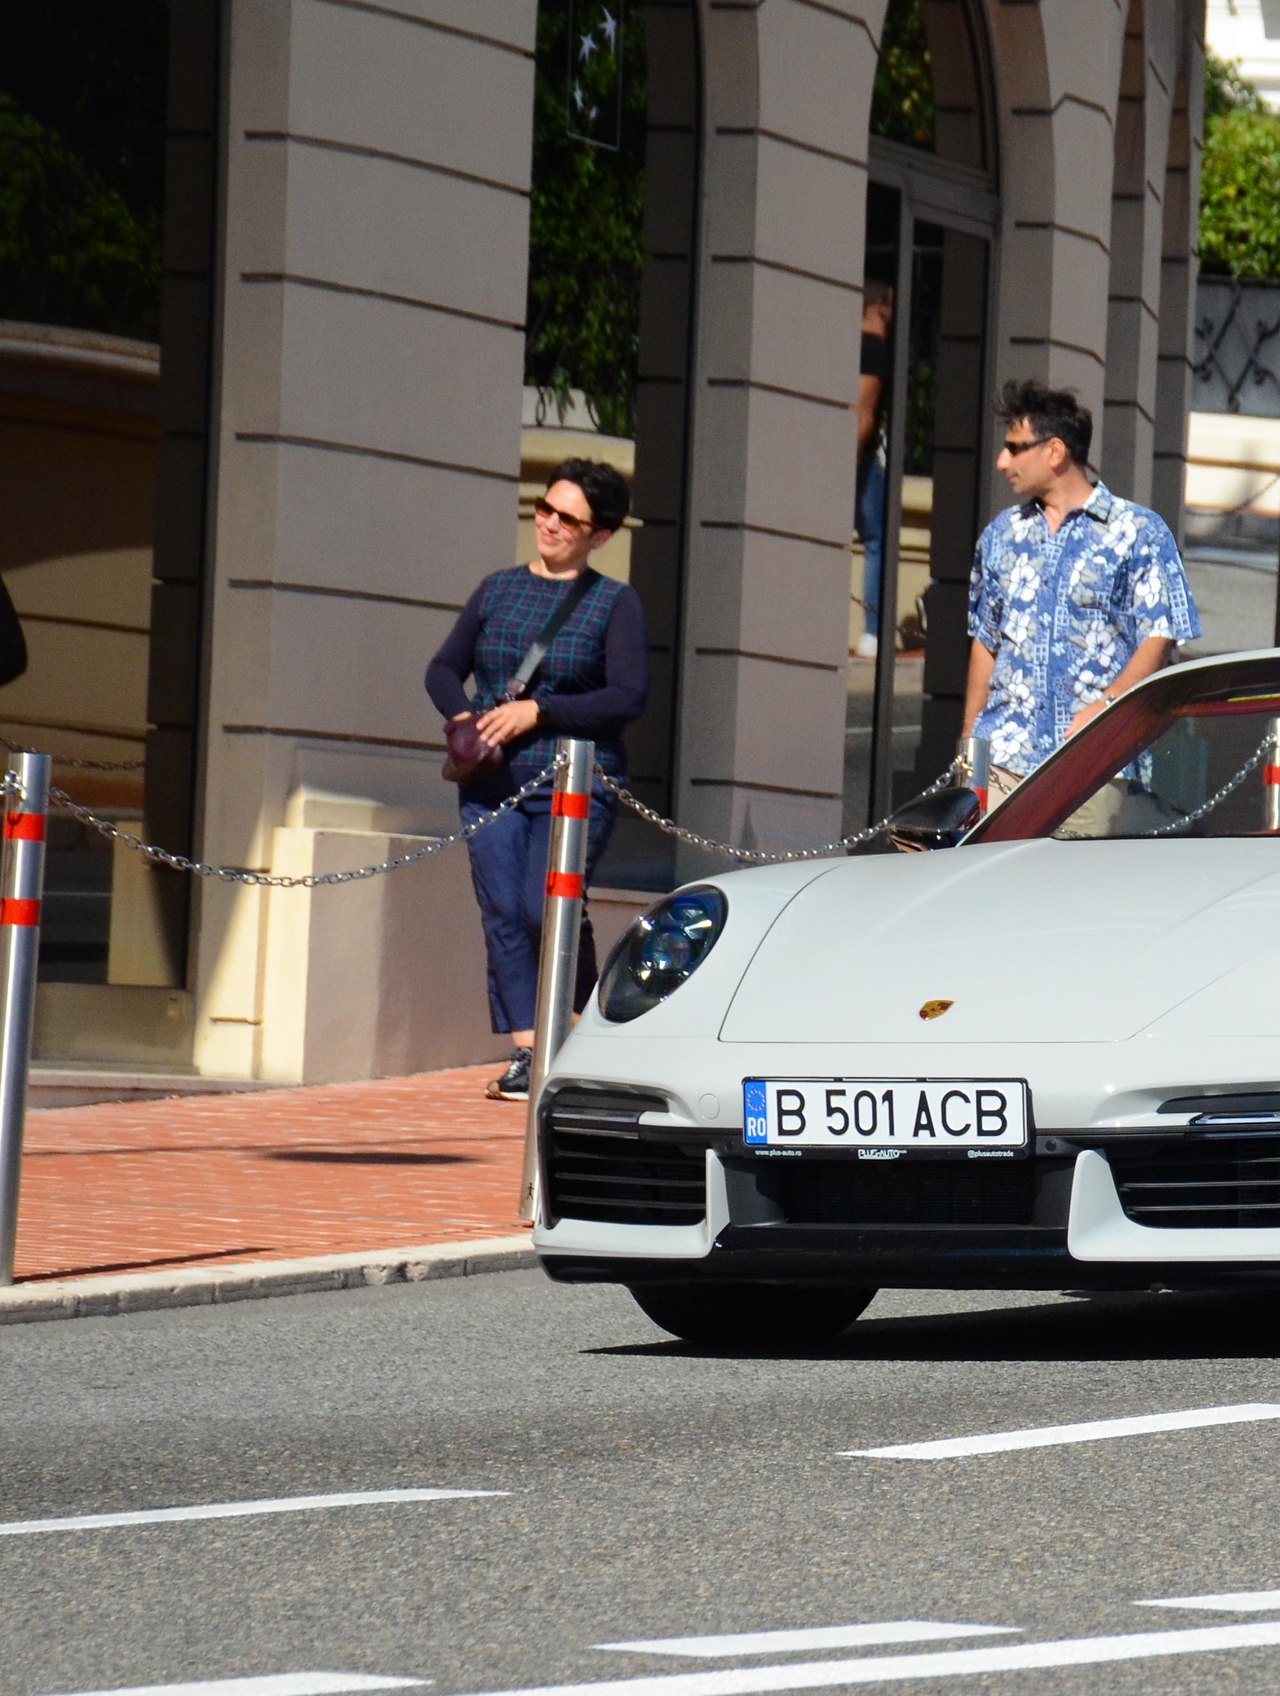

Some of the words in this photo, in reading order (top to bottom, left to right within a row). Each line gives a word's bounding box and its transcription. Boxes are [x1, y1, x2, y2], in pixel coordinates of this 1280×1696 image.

[776, 1089, 806, 1136] B
[825, 1089, 895, 1136] 501
[912, 1089, 1008, 1138] ACB
[747, 1117, 767, 1137] RO
[754, 1149, 802, 1157] www.plus-auto.ro
